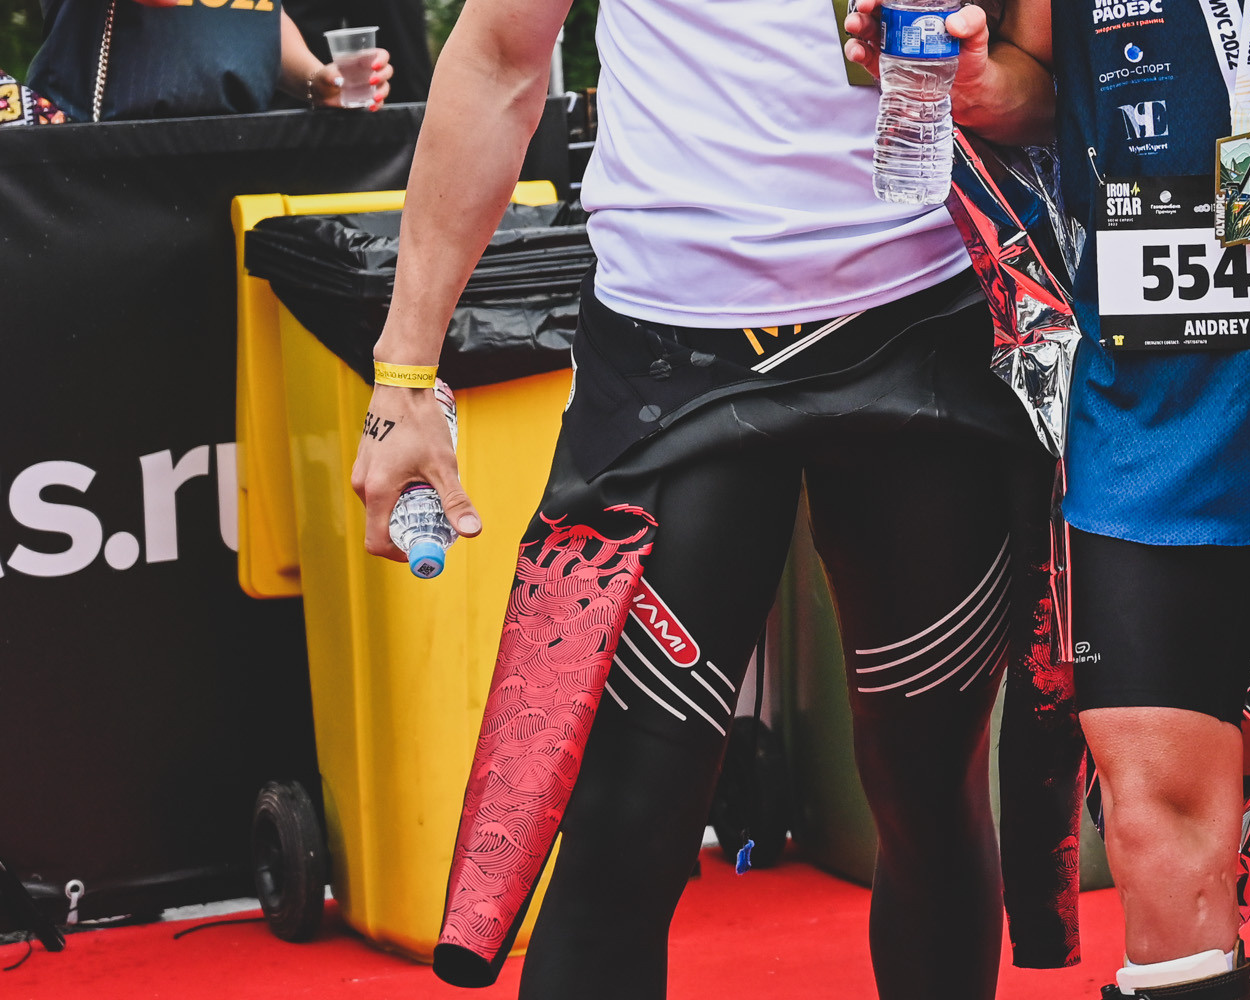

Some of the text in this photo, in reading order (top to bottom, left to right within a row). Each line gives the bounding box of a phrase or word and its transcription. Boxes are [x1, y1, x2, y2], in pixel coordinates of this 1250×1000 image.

[1098, 62, 1172, 83] ОРТО-СПОРТ
[1106, 183, 1130, 197] IRON
[1106, 197, 1142, 216] STAR
[1215, 194, 1226, 237] OLYMPIC
[1184, 318, 1250, 336] ANDREY
